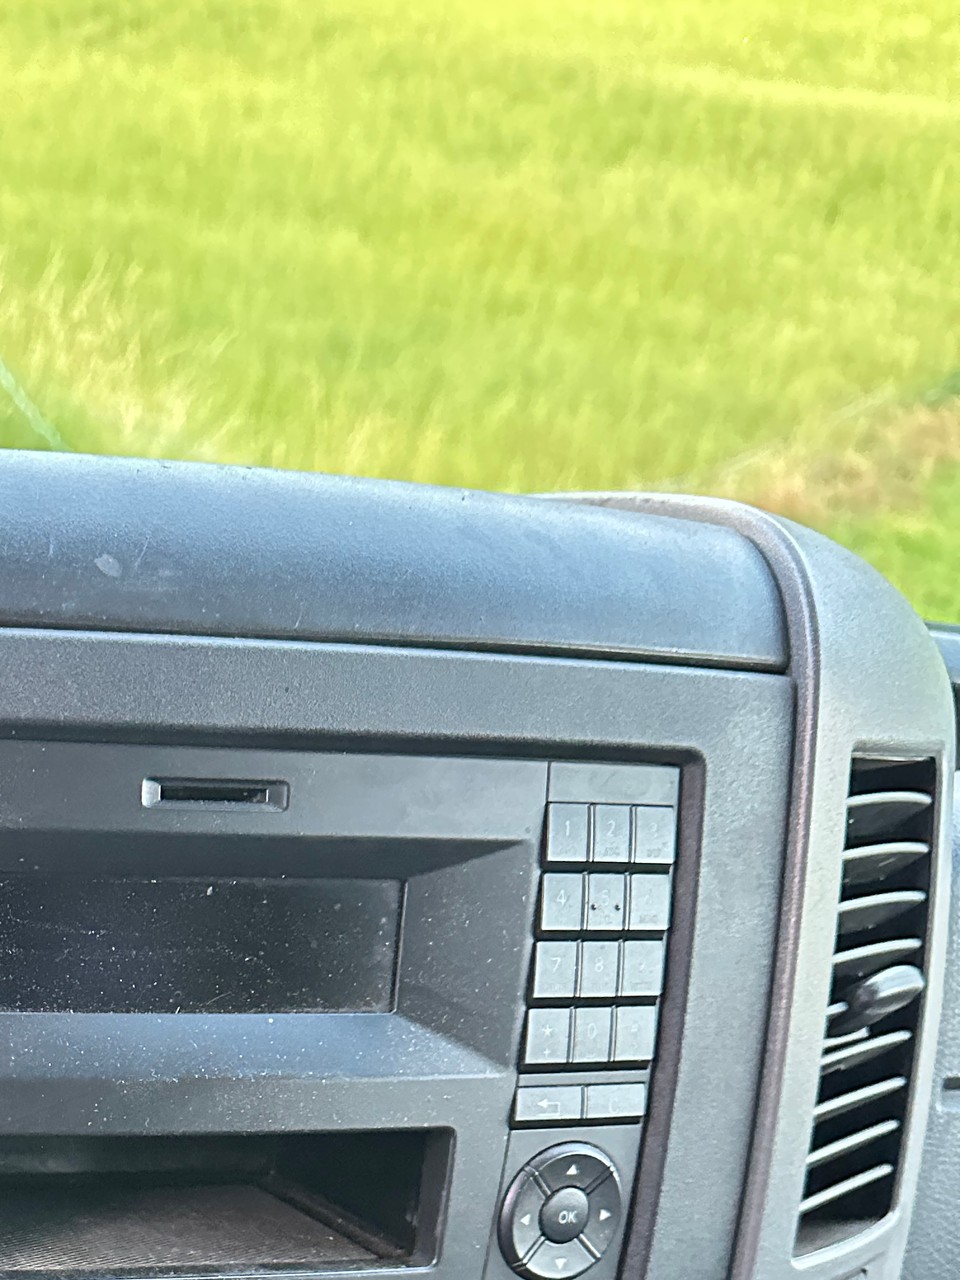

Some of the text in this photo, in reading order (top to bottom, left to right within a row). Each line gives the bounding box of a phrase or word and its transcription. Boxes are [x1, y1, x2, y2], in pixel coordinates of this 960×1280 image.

[565, 819, 571, 837] 1
[606, 819, 617, 838] 2
[555, 888, 568, 907] 4
[550, 956, 562, 974] 7
[594, 955, 605, 973] 8
[558, 1209, 578, 1225] OK
